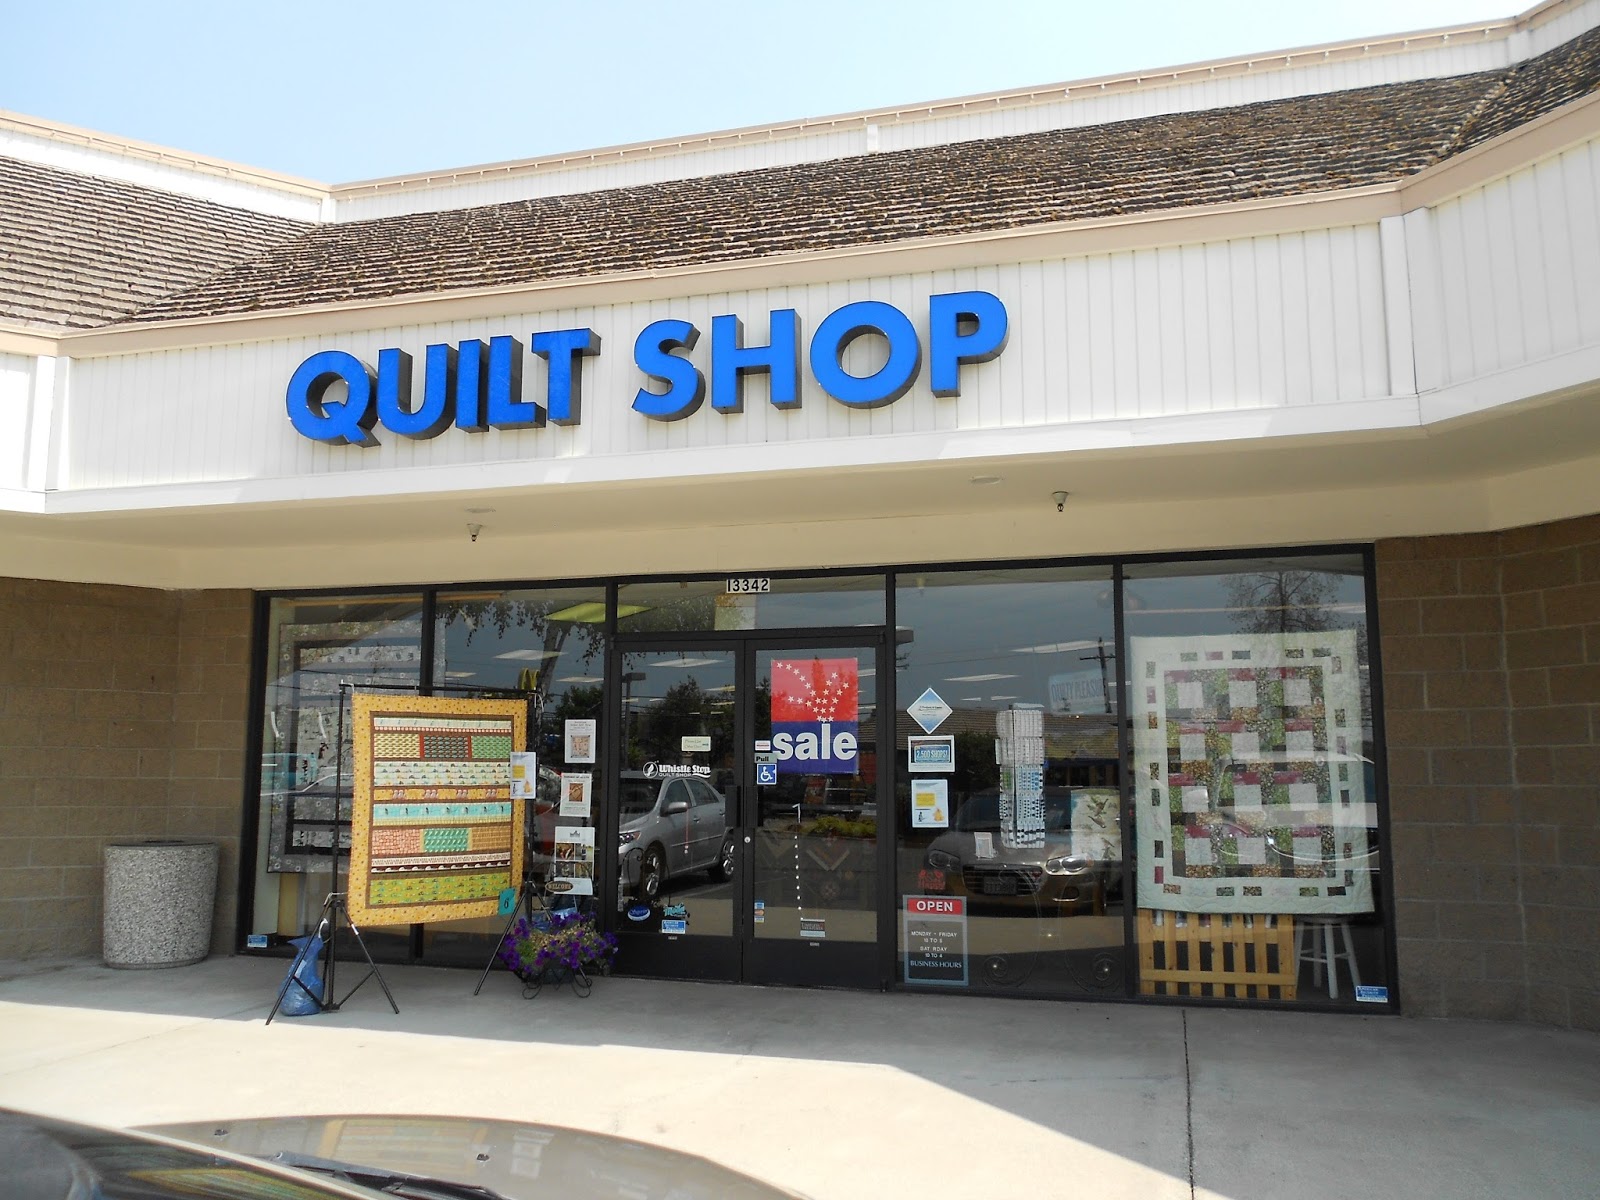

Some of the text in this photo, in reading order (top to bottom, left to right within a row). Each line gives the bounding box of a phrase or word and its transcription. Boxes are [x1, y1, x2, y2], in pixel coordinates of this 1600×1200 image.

[286, 291, 1010, 447] QUILT SHOP
[727, 579, 769, 592] 13342
[772, 723, 858, 761] sale
[658, 764, 711, 774] Whistle Stop
[916, 900, 953, 912] OPEN
[910, 960, 963, 969] BUSINESS HOURS
